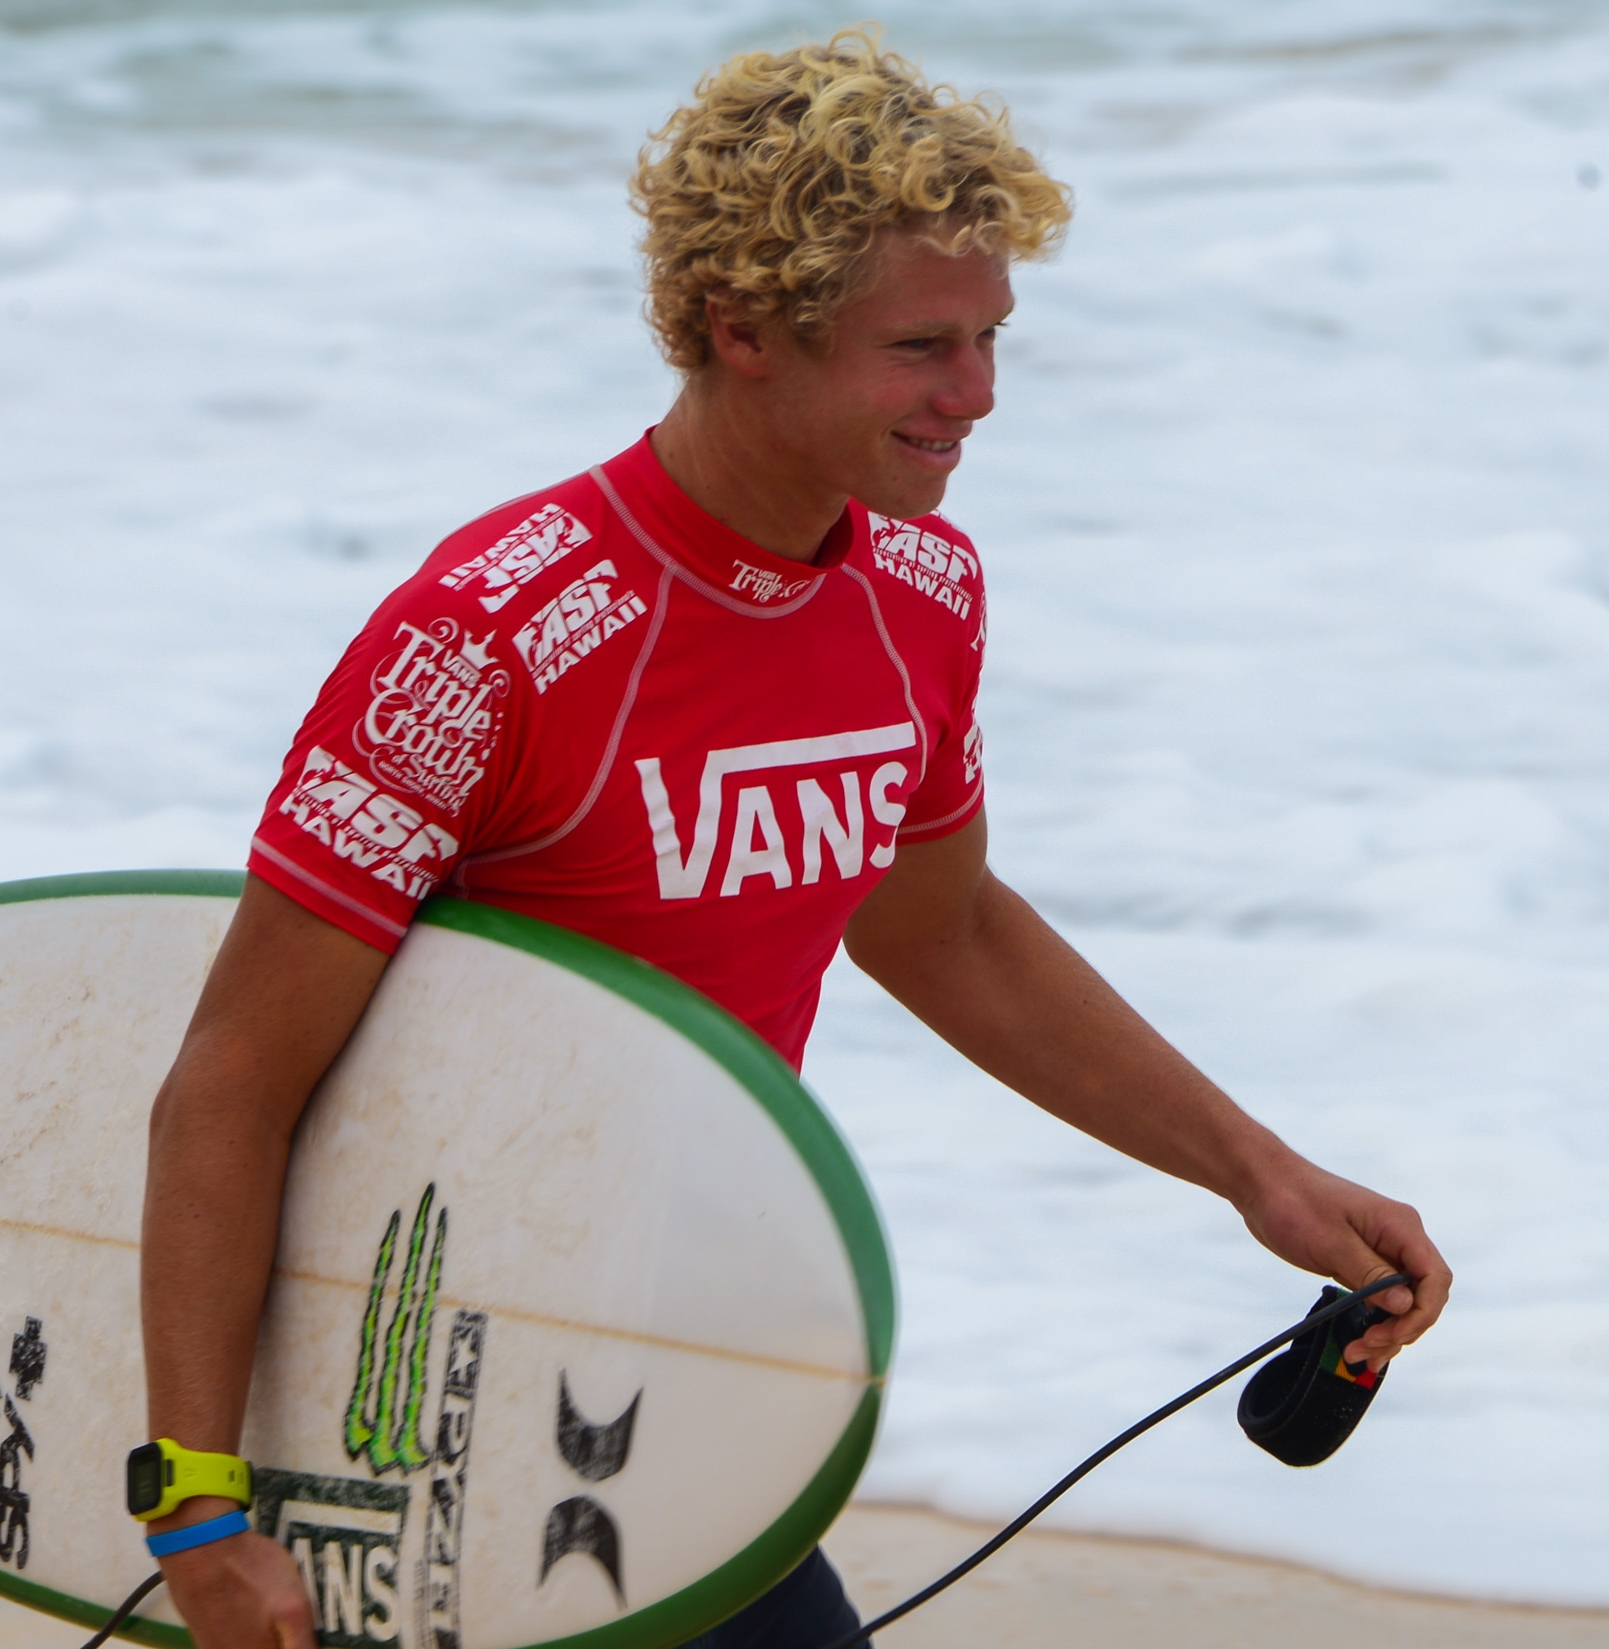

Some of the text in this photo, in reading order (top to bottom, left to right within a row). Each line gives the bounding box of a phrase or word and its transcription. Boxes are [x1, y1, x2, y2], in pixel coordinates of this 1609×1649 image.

[438, 503, 564, 588] HAWAII
[729, 559, 782, 603] Triple
[873, 552, 970, 621] HAWAII
[378, 621, 492, 740] Triple
[441, 649, 483, 689] VANS
[533, 596, 648, 695] HAWAII
[365, 688, 485, 797] Crown
[279, 793, 433, 900] HAWAII
[634, 721, 916, 899] VANS
